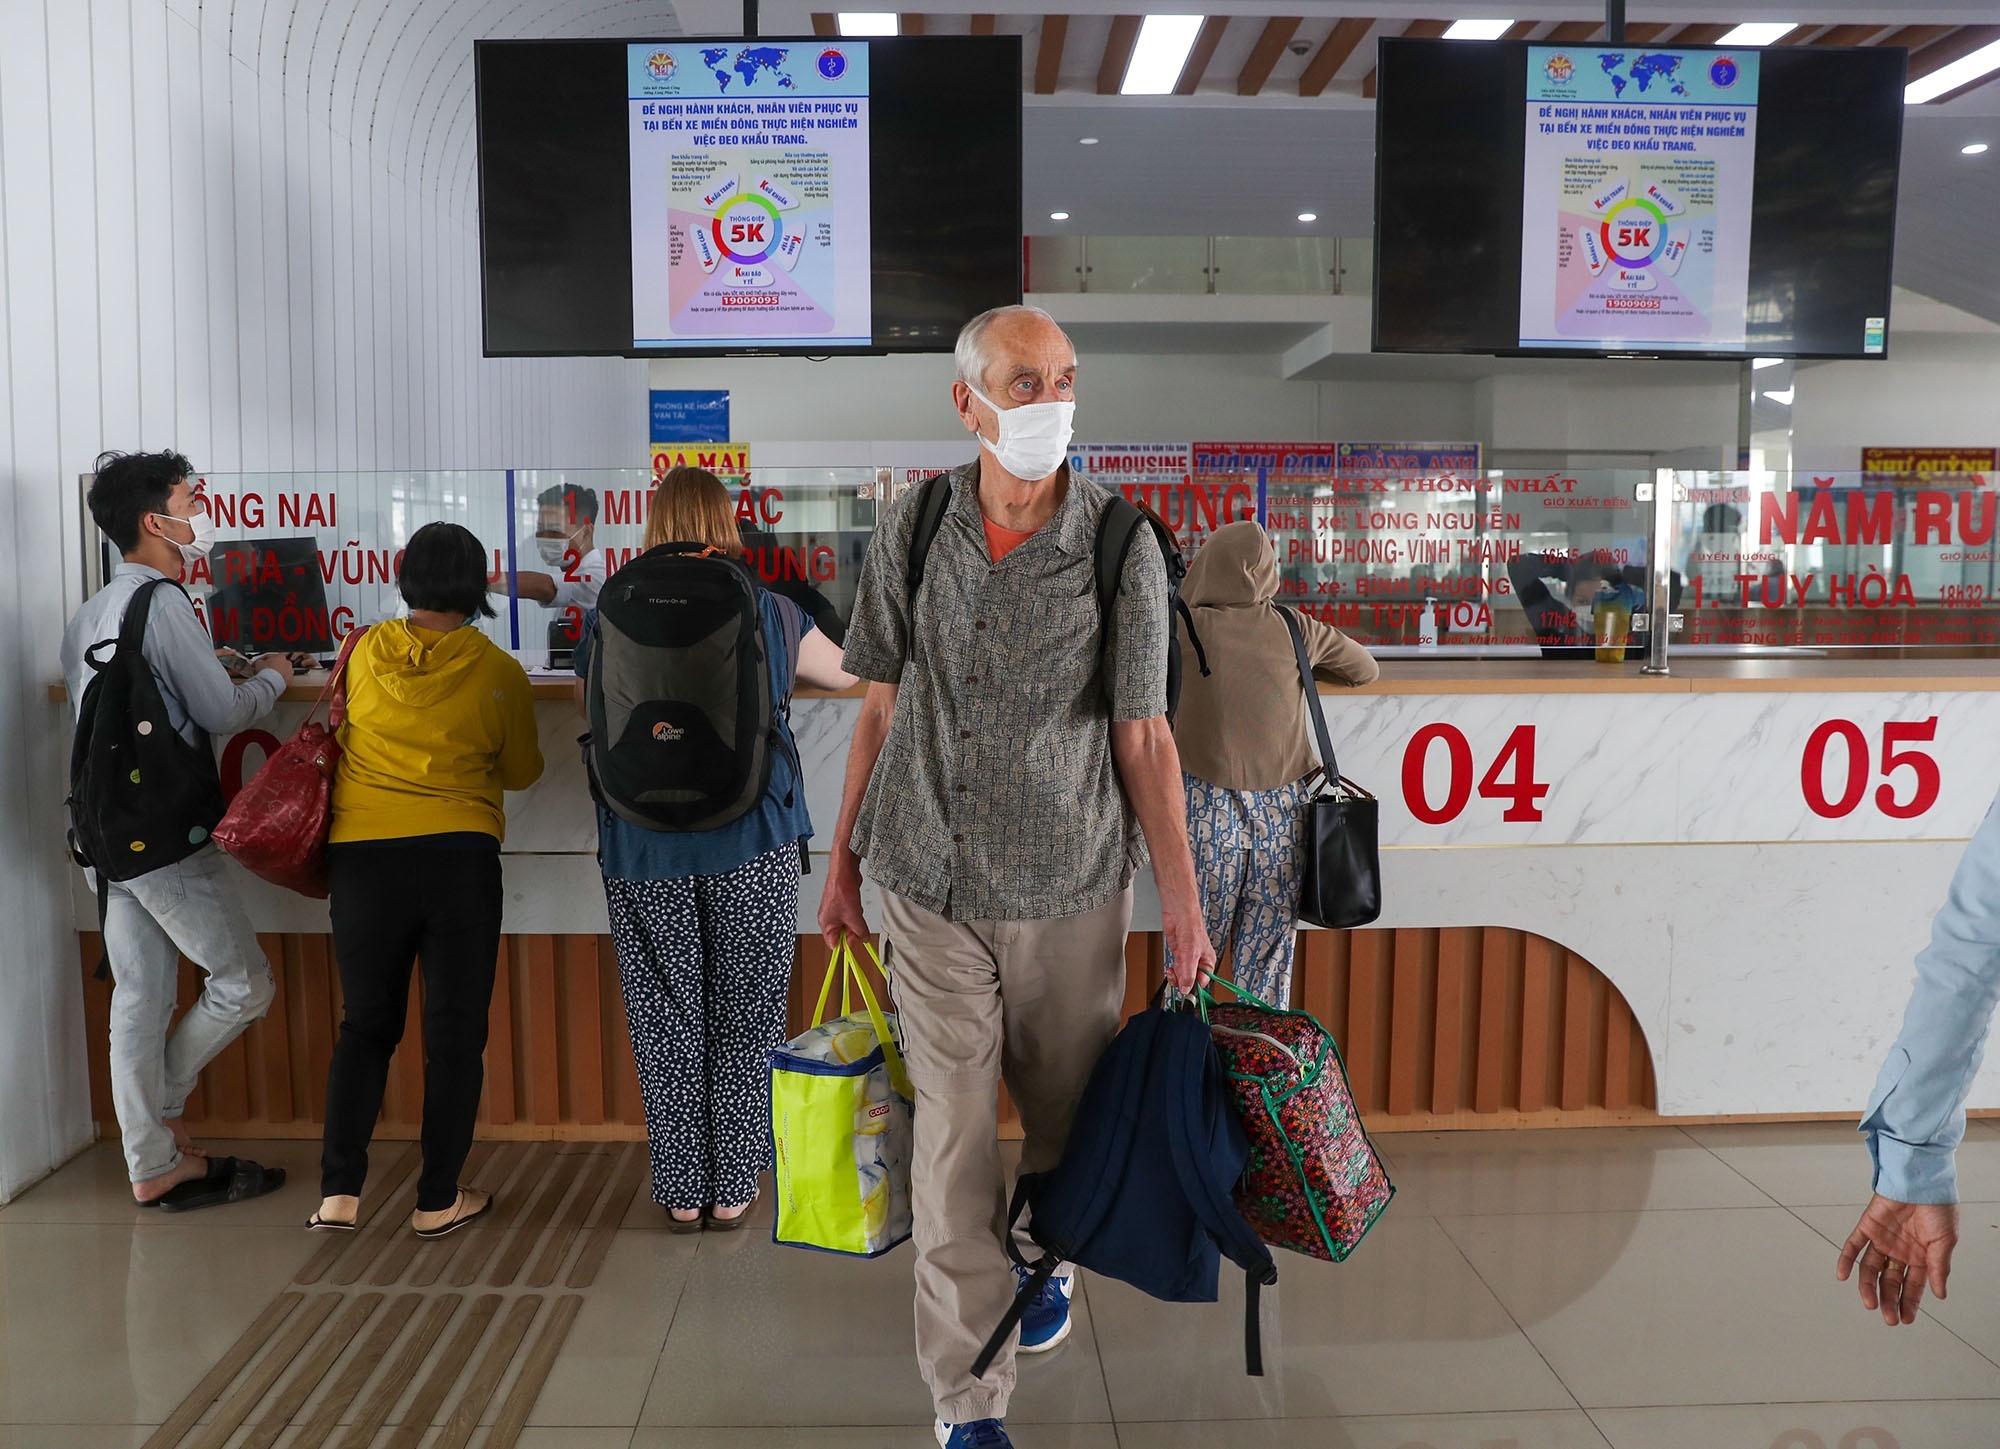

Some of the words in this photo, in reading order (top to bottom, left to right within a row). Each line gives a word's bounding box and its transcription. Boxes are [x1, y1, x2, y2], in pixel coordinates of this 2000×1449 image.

[658, 104, 683, 116] NGHỊ
[686, 103, 714, 114] HÀNH
[717, 102, 754, 114] KHÁCH,
[756, 102, 786, 113] NHÂN
[789, 102, 812, 113] VIÊN
[815, 103, 842, 115] PHỤC
[845, 103, 858, 115] VỤ
[1555, 108, 1578, 120] NGHỊ
[1581, 107, 1608, 119] HÀNH
[1649, 109, 1677, 120] NHÂN
[1680, 109, 1702, 120] VIÊN
[1705, 111, 1731, 123] PHỤC
[1734, 112, 1746, 123] VỤ
[643, 120, 659, 132] TẠI
[662, 117, 682, 130] BẾN
[685, 120, 698, 130] XE
[730, 118, 759, 129] ĐÔNG
[761, 118, 788, 131] THỰC
[790, 117, 815, 131] HIỆN
[818, 117, 858, 129] NGHIÊM
[1539, 123, 1555, 135] TẠI
[1557, 120, 1577, 134] BẾN
[1580, 124, 1593, 134] XE
[1653, 125, 1678, 137] THỰC
[1681, 124, 1704, 138] HIỆN
[1706, 124, 1745, 137] NGHIÊM
[693, 133, 716, 147] VIỆC
[719, 135, 739, 145] ĐEO
[772, 134, 808, 145] TRANG.
[1587, 138, 1609, 152] VIỆC
[1611, 140, 1631, 150] ĐEO
[1662, 141, 1697, 152] TRANG.
[730, 223, 765, 243] 5K
[1617, 227, 1651, 247] 5K
[723, 296, 778, 305] 19009095
[1607, 300, 1659, 308] 19009095
[650, 452, 688, 475] OA
[697, 452, 747, 475] MAI
[1088, 456, 1188, 474] LIMOUSINE
[1341, 449, 1420, 475] HOÀNG
[1428, 455, 1475, 475] ANH
[1866, 455, 1915, 477] NHƯ
[906, 469, 921, 483] CTY
[1331, 478, 1389, 492] HTX
[1398, 472, 1493, 493] THỐNG
[1503, 472, 1578, 493] NHẤT
[563, 490, 591, 525] 1.
[604, 474, 659, 525] MI
[734, 472, 784, 525] ẮC
[1120, 474, 1256, 532] HƯNG
[1543, 497, 1565, 507] GIỜ
[1568, 496, 1600, 507] XUẤT
[278, 492, 337, 528] NAI
[1268, 509, 1310, 530] Nhà
[1317, 514, 1348, 530] xe:
[1355, 512, 1419, 530] LONG
[1759, 476, 1894, 545] NĂM
[1914, 474, 1996, 546] RÙ
[1288, 532, 1326, 564] PHÚ
[1407, 532, 1450, 563] VĨNH
[1592, 547, 1628, 565] 16h30
[225, 550, 284, 593] RỊA
[563, 548, 592, 583] 2.
[742, 545, 836, 583] UNG
[1316, 581, 1347, 595] xe:
[1356, 573, 1408, 595] BÌNH
[1417, 575, 1510, 595] PHƯƠNG
[1689, 574, 1719, 609] 1.
[1733, 573, 1815, 609] TUY
[1829, 564, 1917, 609] HÒA
[252, 592, 355, 643] ĐỒNG
[1370, 603, 1425, 628] TUY
[1435, 596, 1493, 628] HÒA
[1539, 611, 1578, 628] 17h42
[1717, 630, 1778, 645] PHÒNG
[656, 733, 681, 742] alpine
[662, 727, 685, 735] Lowe
[1401, 722, 1550, 825] 04
[1801, 715, 1940, 819] 05
[869, 1105, 890, 1117] COOP
